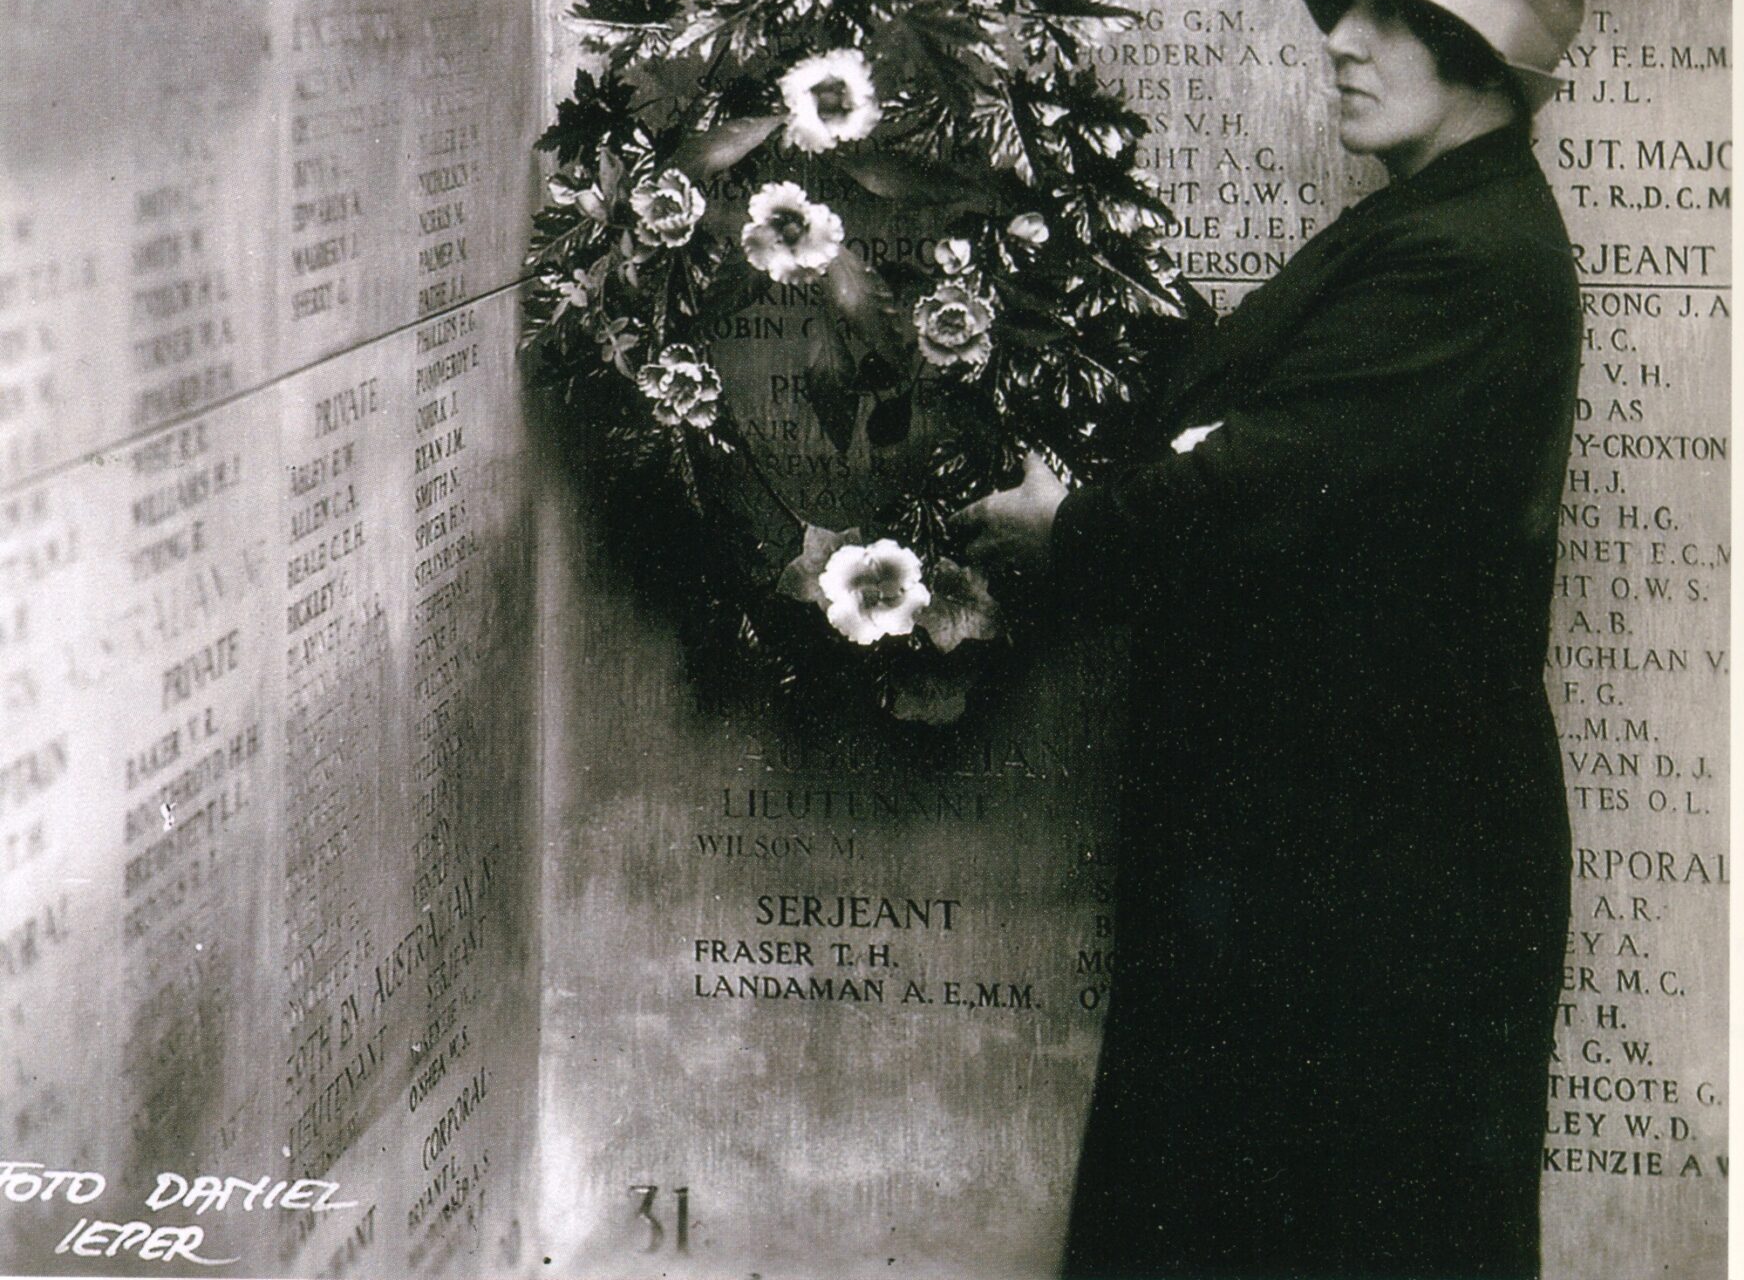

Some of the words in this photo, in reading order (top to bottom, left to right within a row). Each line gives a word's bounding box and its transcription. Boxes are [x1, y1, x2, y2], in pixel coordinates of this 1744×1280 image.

[1593, 11, 1618, 33] T.
[1559, 138, 1624, 170] SJT.
[315, 378, 378, 438] PRIVATE
[1706, 651, 1729, 673] V.
[696, 834, 813, 858] WILSON
[757, 895, 961, 930] SERJEANT
[694, 939, 813, 966] FRASER
[1617, 934, 1649, 958] A.
[694, 976, 884, 1003] LANDAMAN
[1597, 1005, 1626, 1029] H.
[1697, 1083, 1722, 1105] G.
[629, 1184, 690, 1255] 31
